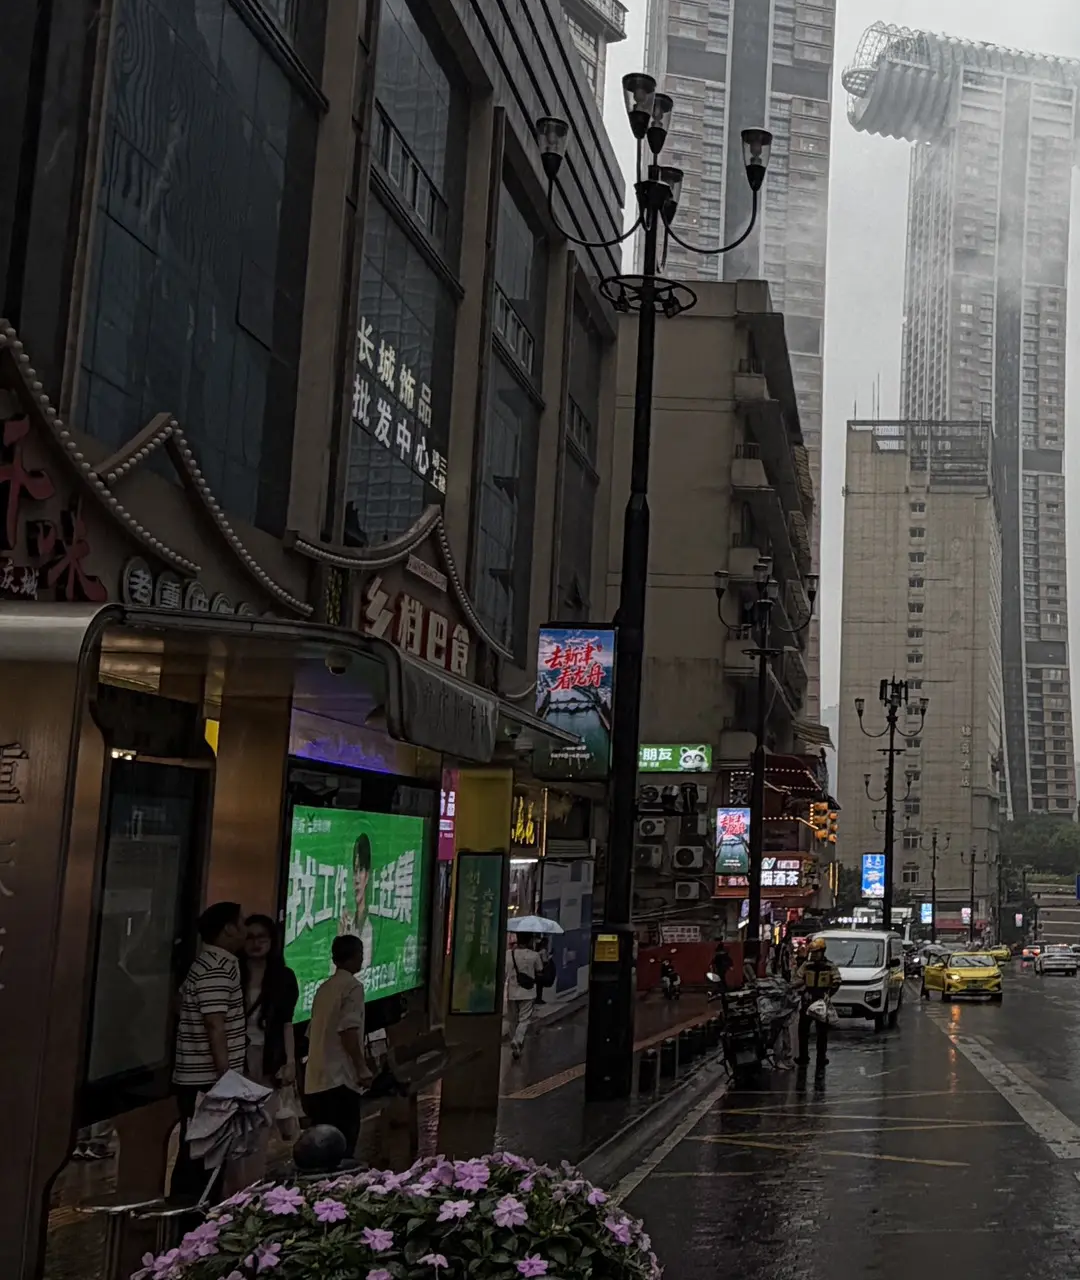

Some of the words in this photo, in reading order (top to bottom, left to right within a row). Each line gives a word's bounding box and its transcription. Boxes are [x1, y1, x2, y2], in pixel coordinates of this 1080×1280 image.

[357, 316, 433, 428] 长城饰品
[352, 373, 430, 475] 批发中心
[640, 748, 673, 761] 朋友
[284, 849, 349, 947] 找工作
[368, 850, 416, 924] 上赶集
